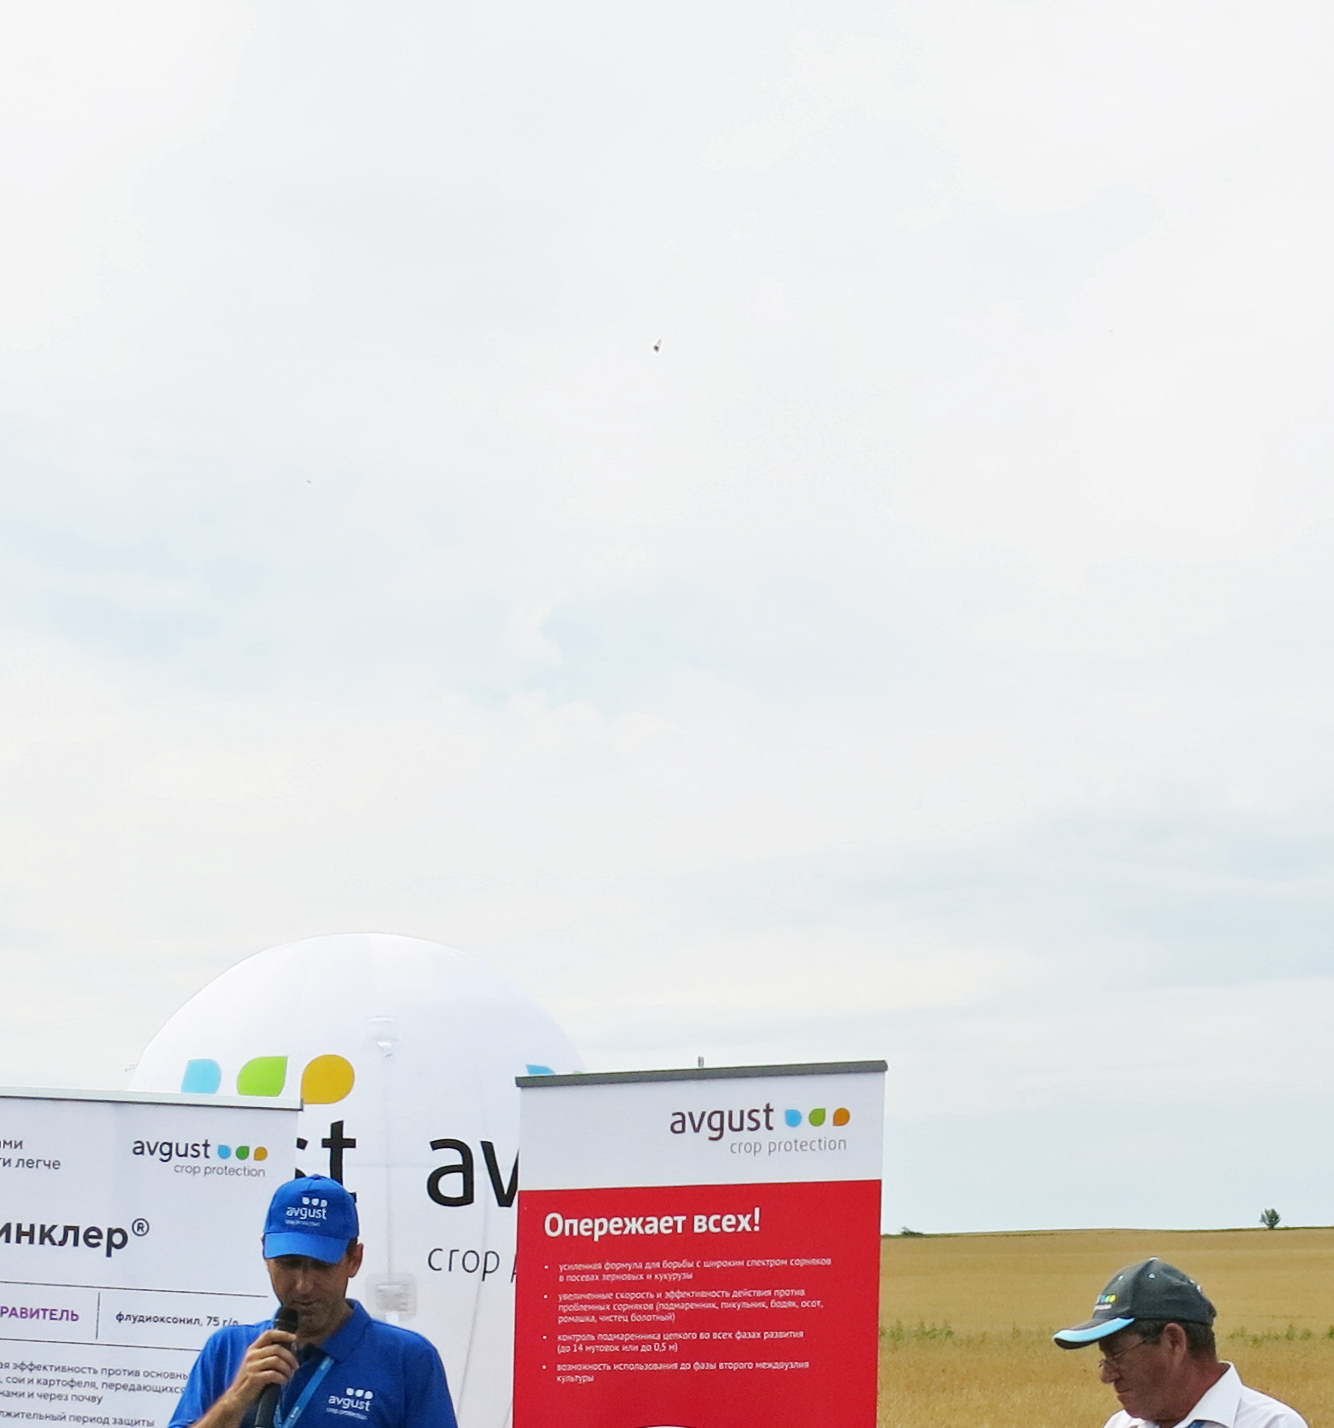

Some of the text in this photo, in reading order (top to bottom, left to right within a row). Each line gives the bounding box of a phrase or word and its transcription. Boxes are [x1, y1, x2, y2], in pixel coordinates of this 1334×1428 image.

[670, 1103, 774, 1140] avgust
[132, 1138, 211, 1164] avgust
[730, 1137, 847, 1156] crop protection
[14, 1157, 62, 1170] легче
[174, 1163, 266, 1178] crop protection
[286, 1206, 327, 1220] avgust
[544, 1207, 761, 1241] Опережает всех!
[427, 1247, 501, 1281] crop
[654, 1272, 694, 1282] кукурузы
[615, 1291, 655, 1301] скорость
[774, 1288, 806, 1298] против
[116, 1311, 220, 1326] флудиоксонил, 75
[572, 1343, 584, 1352] 14
[12, 1361, 98, 1374] эффективность
[101, 1367, 141, 1378] против
[143, 1370, 188, 1380] основны
[693, 1361, 717, 1372] фазы
[5, 1376, 25, 1384] сои
[36, 1377, 99, 1389] картофеля,
[36, 1392, 68, 1402] через
[71, 1394, 103, 1405] почву
[328, 1395, 371, 1412] avgust
[68, 1414, 110, 1425] период
[112, 1417, 155, 1428] защиты
